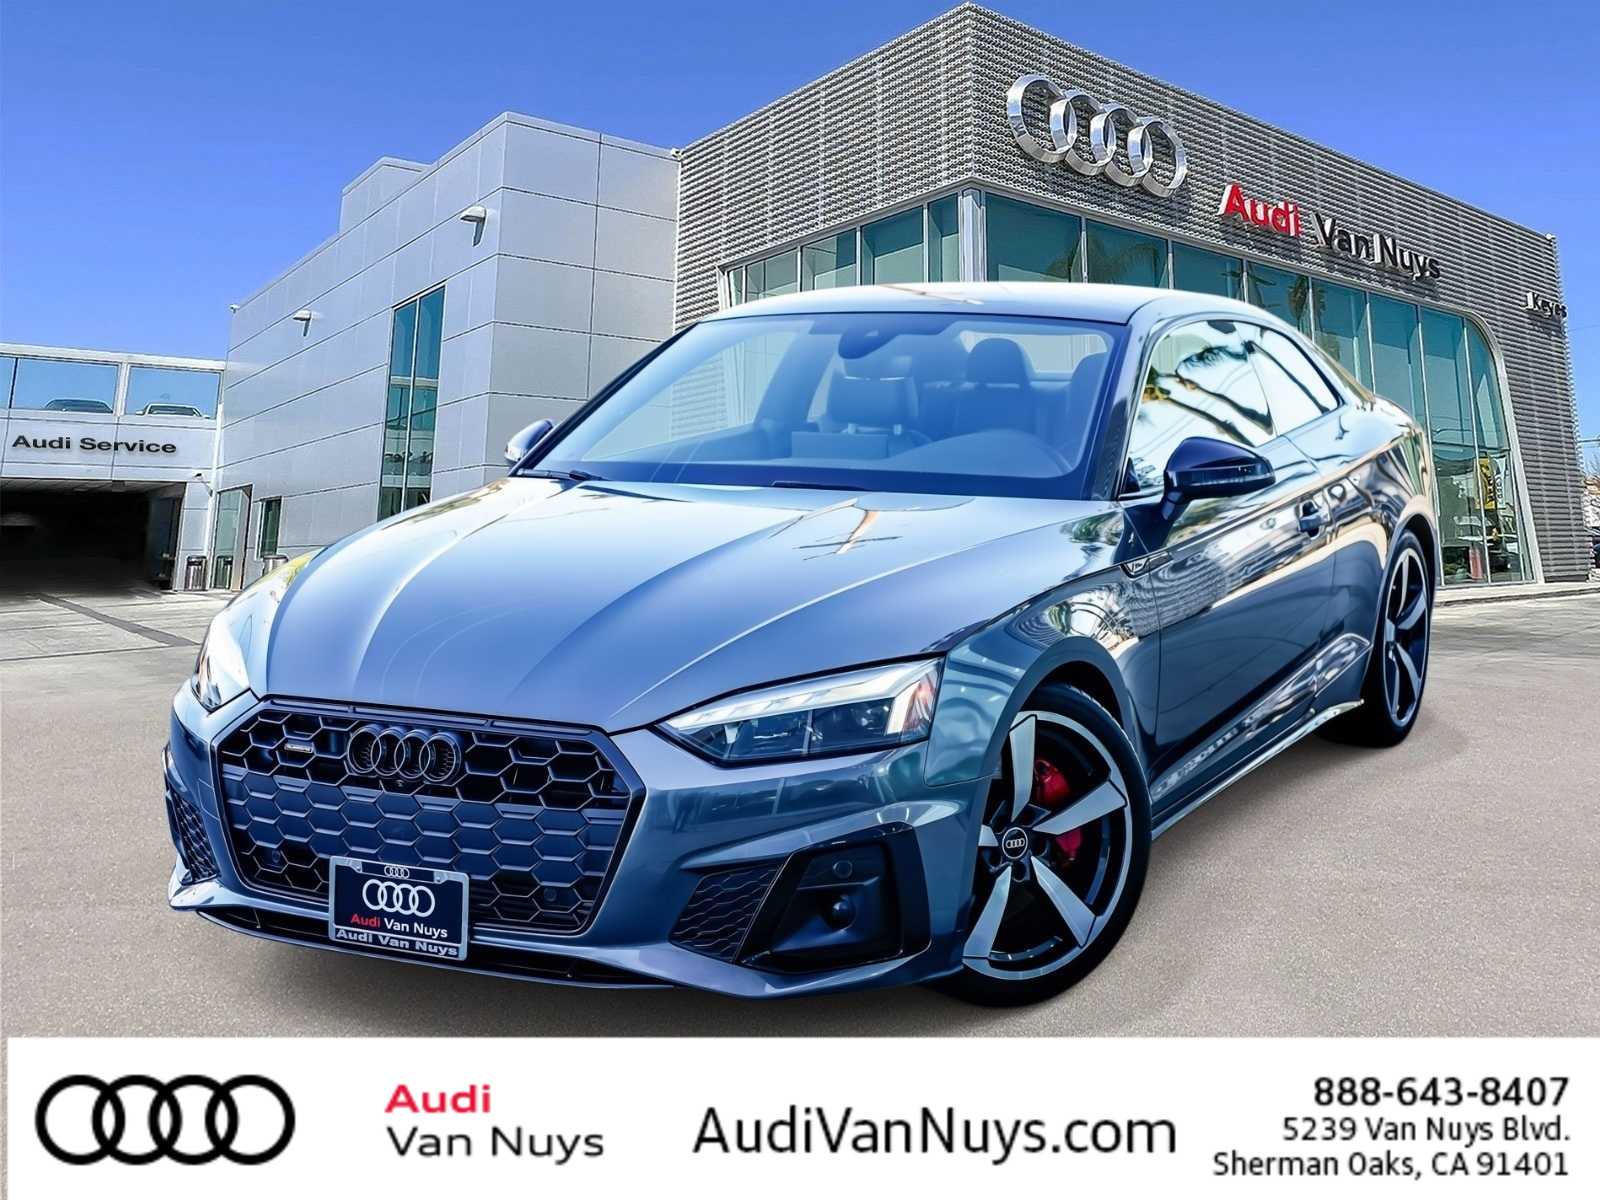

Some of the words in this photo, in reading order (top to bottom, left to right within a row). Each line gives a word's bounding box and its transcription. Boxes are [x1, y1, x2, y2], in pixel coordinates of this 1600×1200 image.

[1218, 183, 1303, 237] Audi
[1313, 211, 1371, 259] Van
[1374, 233, 1441, 280] Nuys
[1526, 291, 1568, 319] Keyes
[12, 435, 71, 449] Audi
[79, 437, 177, 453] Service
[350, 913, 381, 928] Audi
[383, 917, 410, 932] Van
[413, 922, 448, 939] Nuys
[336, 929, 373, 943] Audi
[377, 935, 410, 949] Van
[415, 940, 458, 956] Nuys
